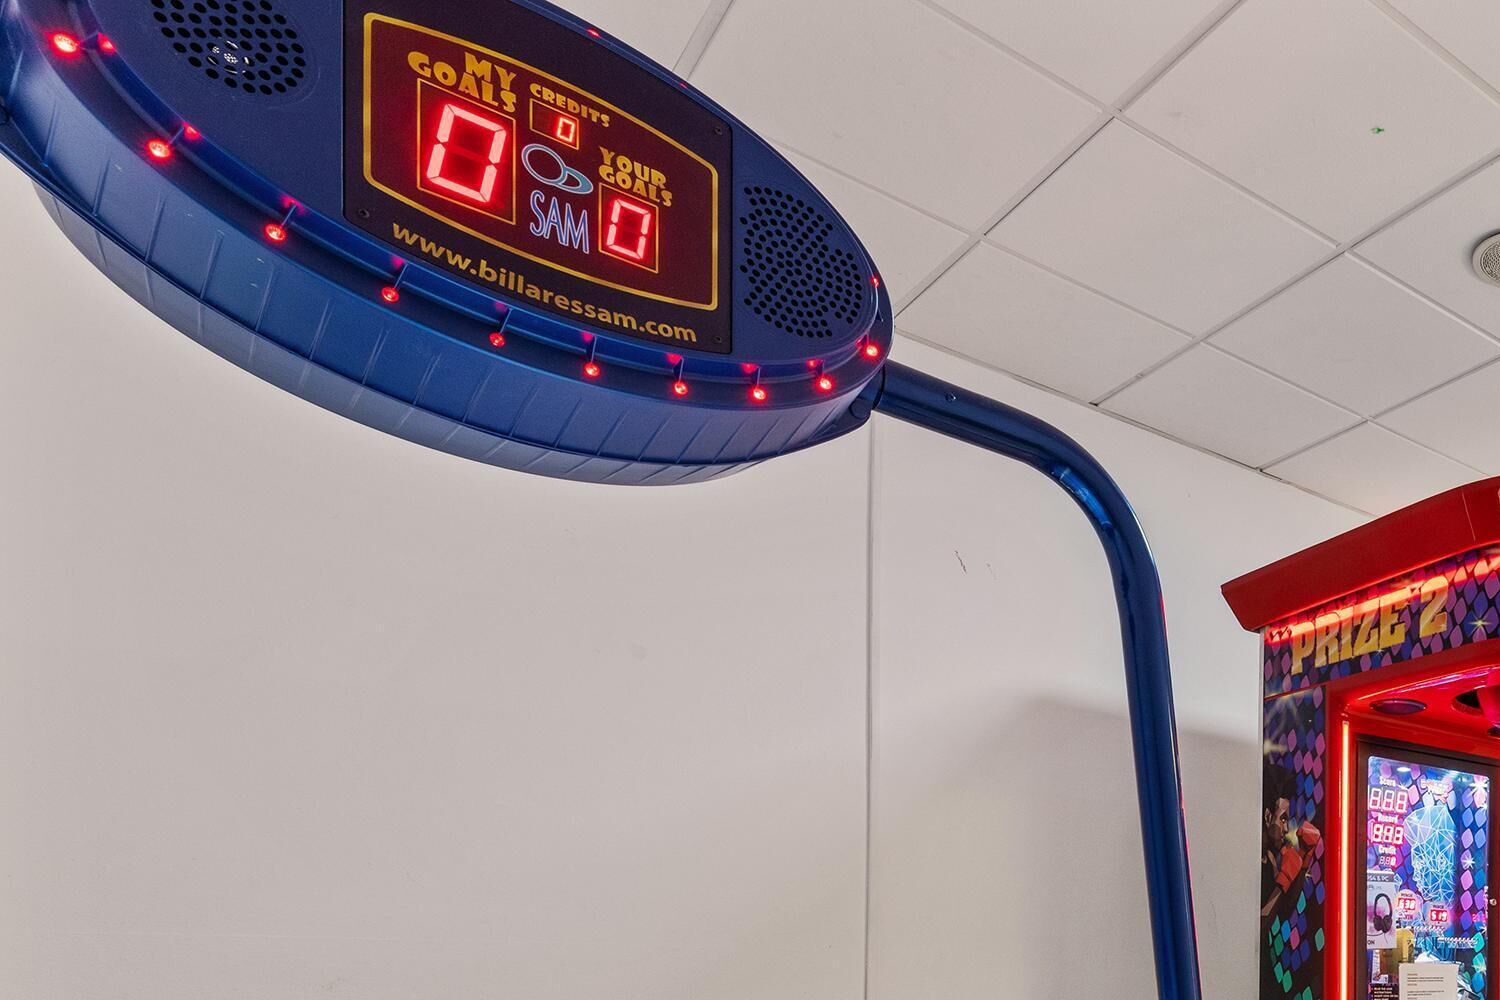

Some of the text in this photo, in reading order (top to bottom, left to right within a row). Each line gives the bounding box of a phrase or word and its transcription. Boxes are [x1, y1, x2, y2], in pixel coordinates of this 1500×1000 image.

[407, 51, 517, 113] GOALS
[465, 52, 516, 91] MY
[529, 82, 611, 128] CREDITS
[556, 117, 575, 143] 0
[427, 104, 507, 202] 0
[599, 146, 667, 189] YOUR
[598, 165, 673, 207] GOALS
[530, 190, 590, 255] SAM
[605, 199, 651, 259] 0
[392, 223, 697, 342] www.billaressam.com
[1291, 575, 1448, 675] PRIZE 2
